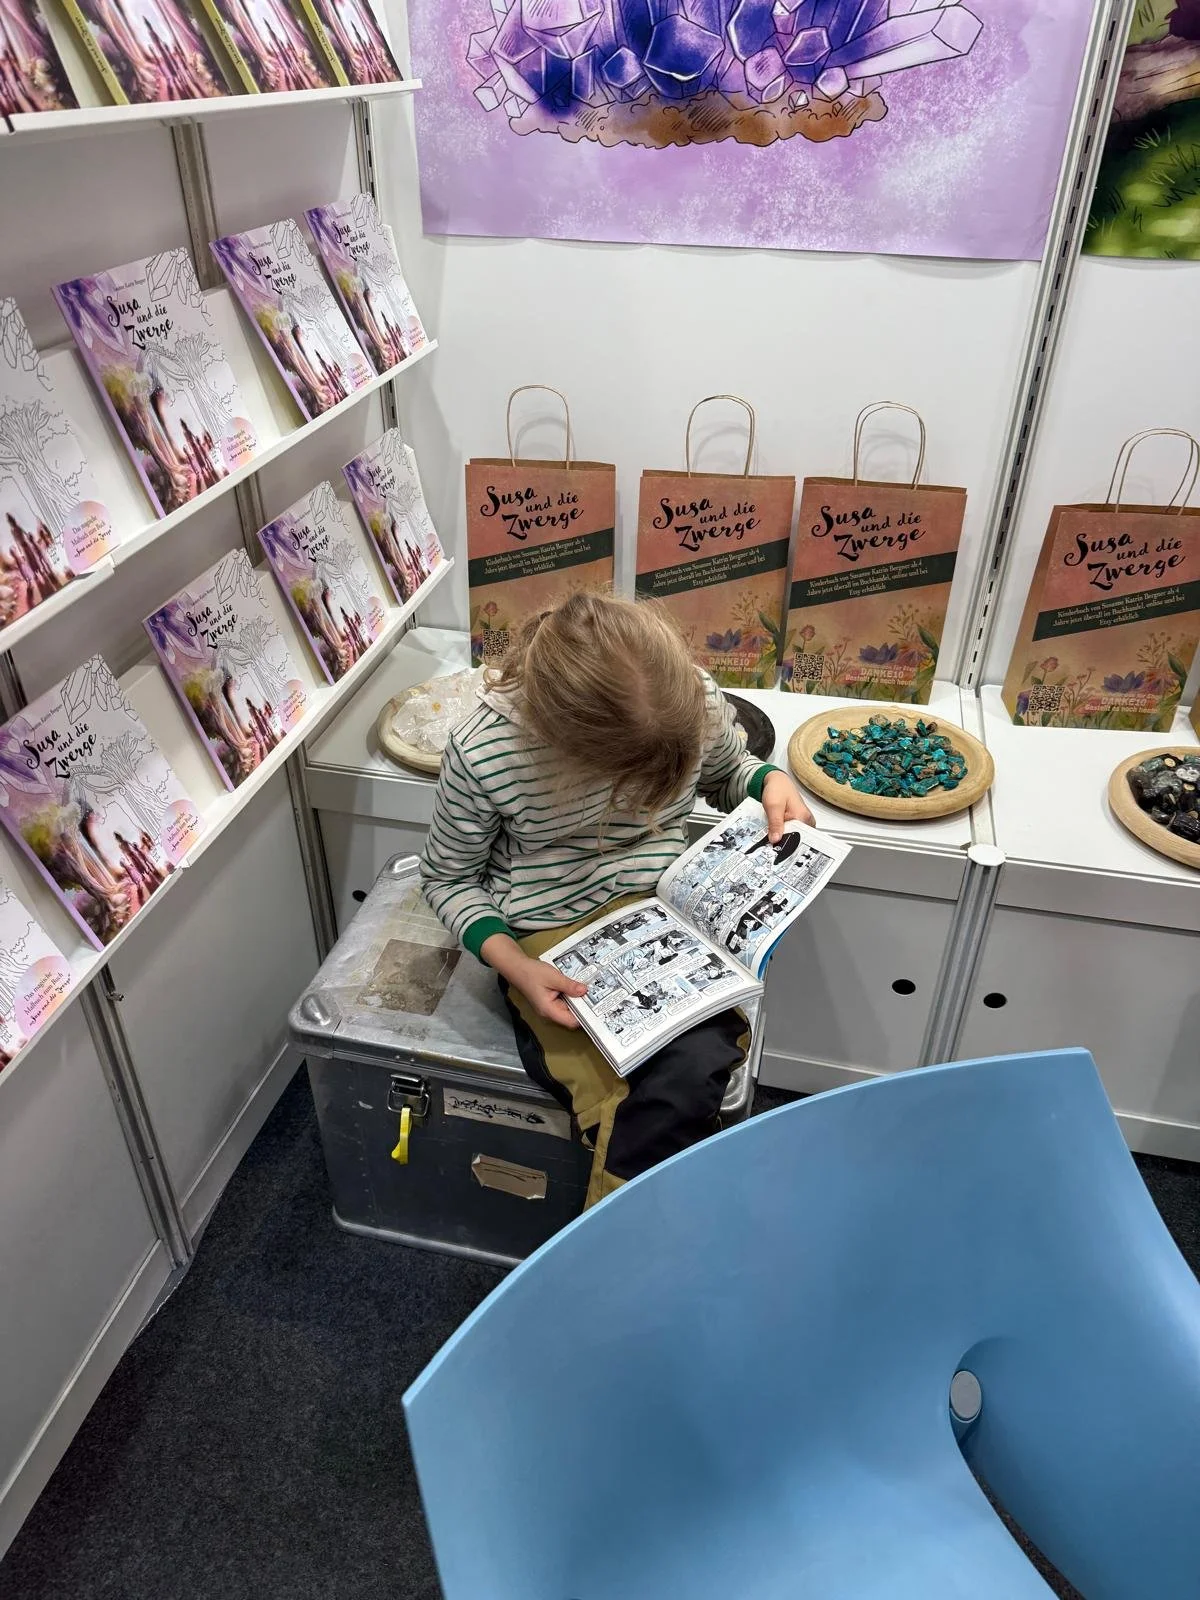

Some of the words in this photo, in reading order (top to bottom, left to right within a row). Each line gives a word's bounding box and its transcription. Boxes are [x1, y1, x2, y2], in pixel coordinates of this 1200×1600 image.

[248, 252, 273, 276] Susa
[264, 274, 297, 295] Zwerge
[106, 296, 141, 328] Susa
[137, 307, 153, 324] und
[154, 304, 168, 316] die
[124, 319, 174, 350] Zwerge
[480, 486, 538, 516] Susa
[526, 496, 552, 513] und
[557, 491, 579, 506] die
[653, 498, 713, 530] Susa
[700, 506, 728, 524] und
[734, 502, 756, 516] die
[502, 508, 584, 540] Zwerge
[674, 518, 760, 552] Zwerge
[811, 506, 876, 538] Susa
[861, 516, 891, 532] und
[897, 512, 922, 526] die
[290, 526, 310, 550] Susa
[302, 535, 330, 562] Zwerge
[834, 528, 926, 562] Zwerge
[1064, 533, 1134, 566] Susa
[1117, 542, 1149, 560] und
[1156, 538, 1182, 552] die
[810, 576, 838, 588] Kinderbuch
[872, 566, 889, 575] Katrin
[909, 569, 920, 577] und
[1088, 554, 1186, 590] Zwerge
[186, 606, 212, 637] Susa
[210, 610, 222, 626] und
[223, 604, 234, 616] die
[1058, 606, 1090, 618] Kinderbuch
[200, 614, 238, 650] Zwerge
[861, 668, 904, 679] DANKE10
[23, 730, 61, 770] Susa
[58, 732, 74, 752] und
[75, 723, 90, 738] die
[44, 734, 96, 778] Zwerge
